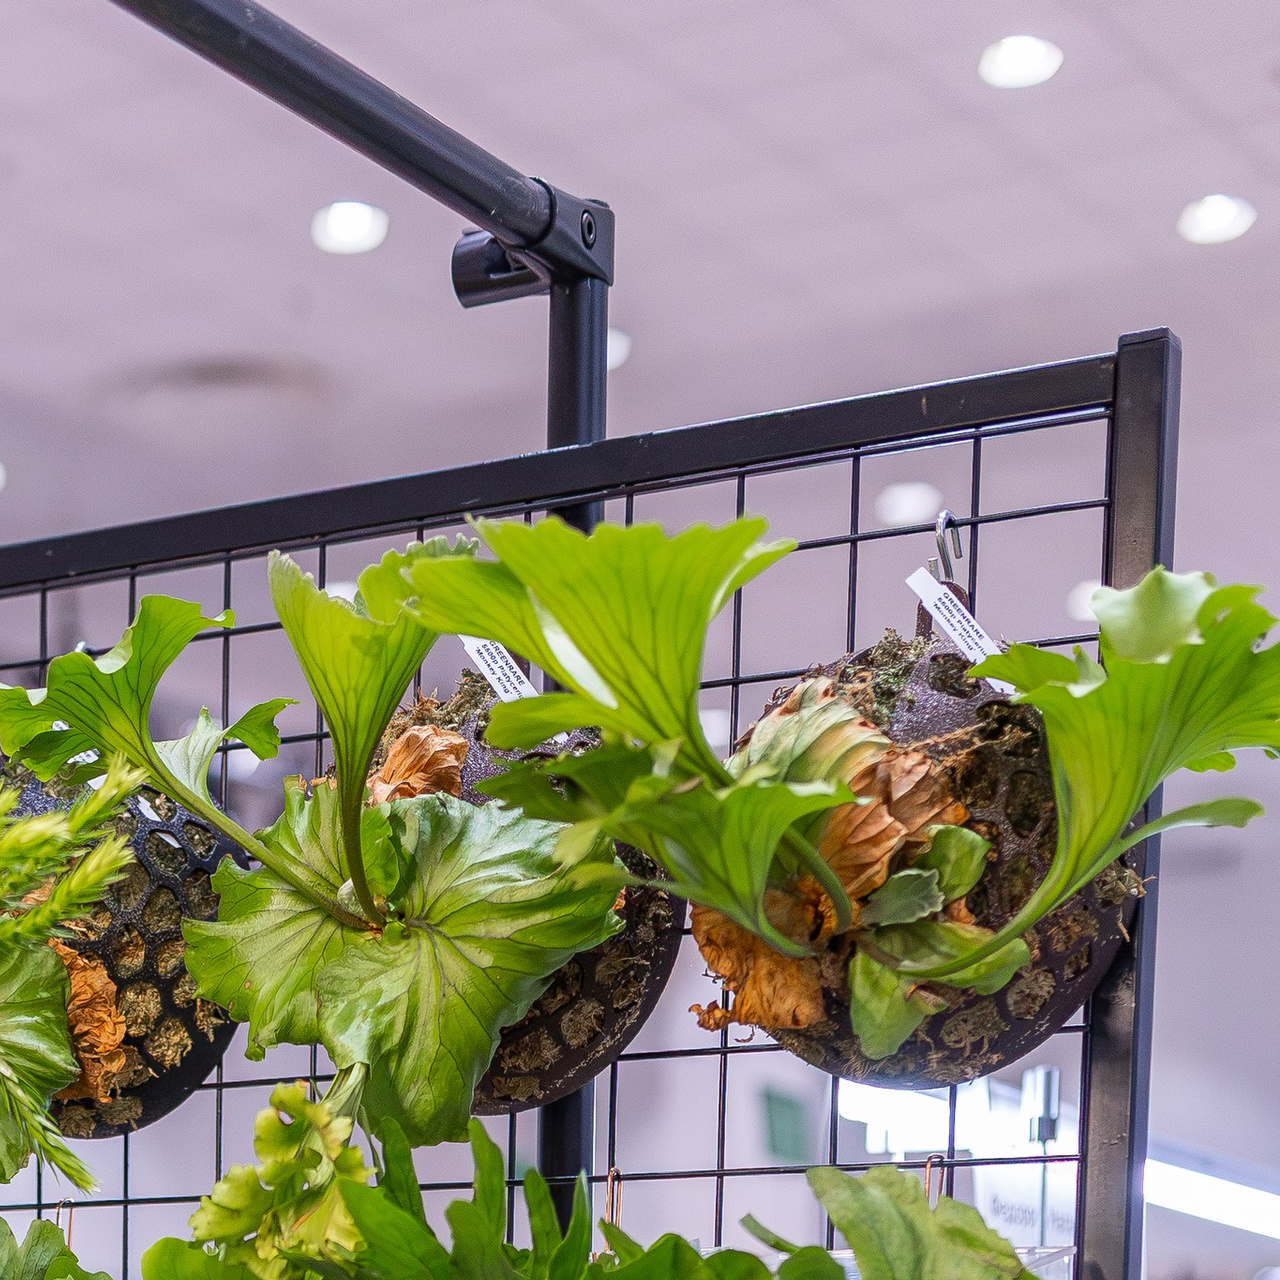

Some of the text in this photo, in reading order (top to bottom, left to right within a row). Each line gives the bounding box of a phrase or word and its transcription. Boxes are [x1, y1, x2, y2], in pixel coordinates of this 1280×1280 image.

[943, 592, 985, 641] GREENRARE
[956, 620, 988, 656] Platyceriu
[489, 641, 525, 686] GREENRARE
[497, 665, 525, 699] Platyceriu
